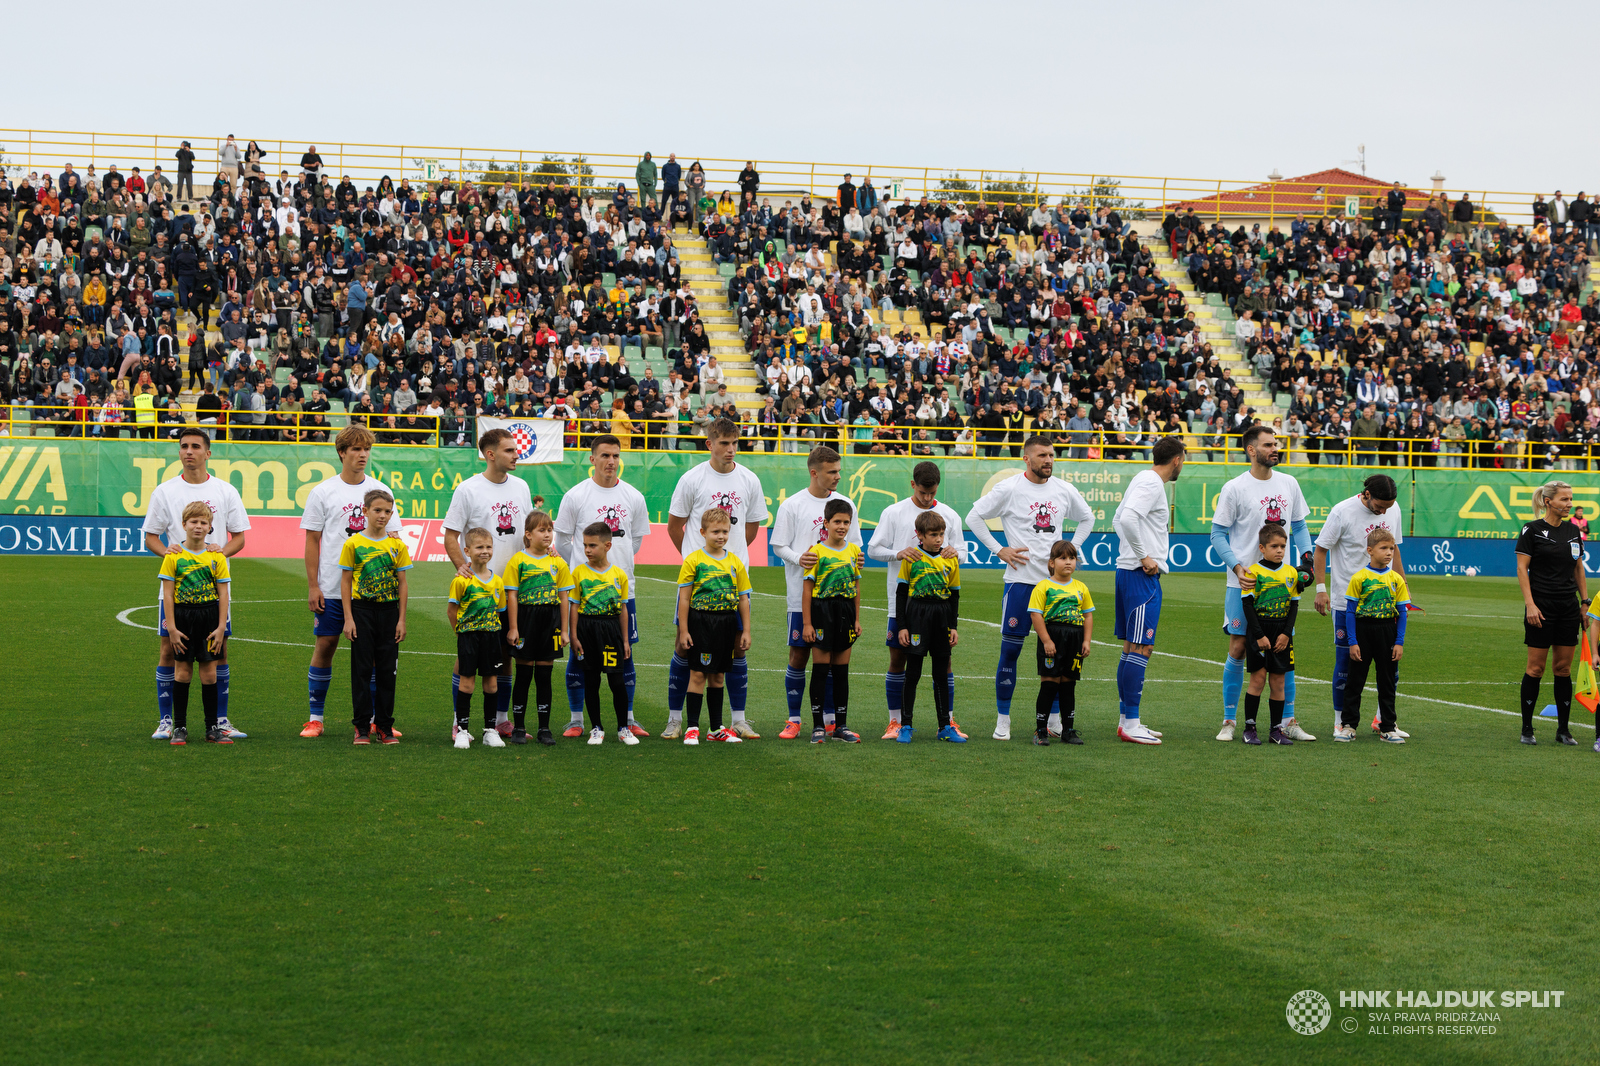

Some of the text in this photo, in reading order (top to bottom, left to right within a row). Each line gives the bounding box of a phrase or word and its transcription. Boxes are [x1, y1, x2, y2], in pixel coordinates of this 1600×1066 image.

[427, 164, 436, 180] E
[893, 183, 902, 198] F
[1348, 201, 1356, 216] G
[371, 468, 480, 490] VRAĆA
[1080, 488, 1122, 503] editna
[1408, 564, 1482, 573] MON PERN
[603, 651, 617, 667] 15
